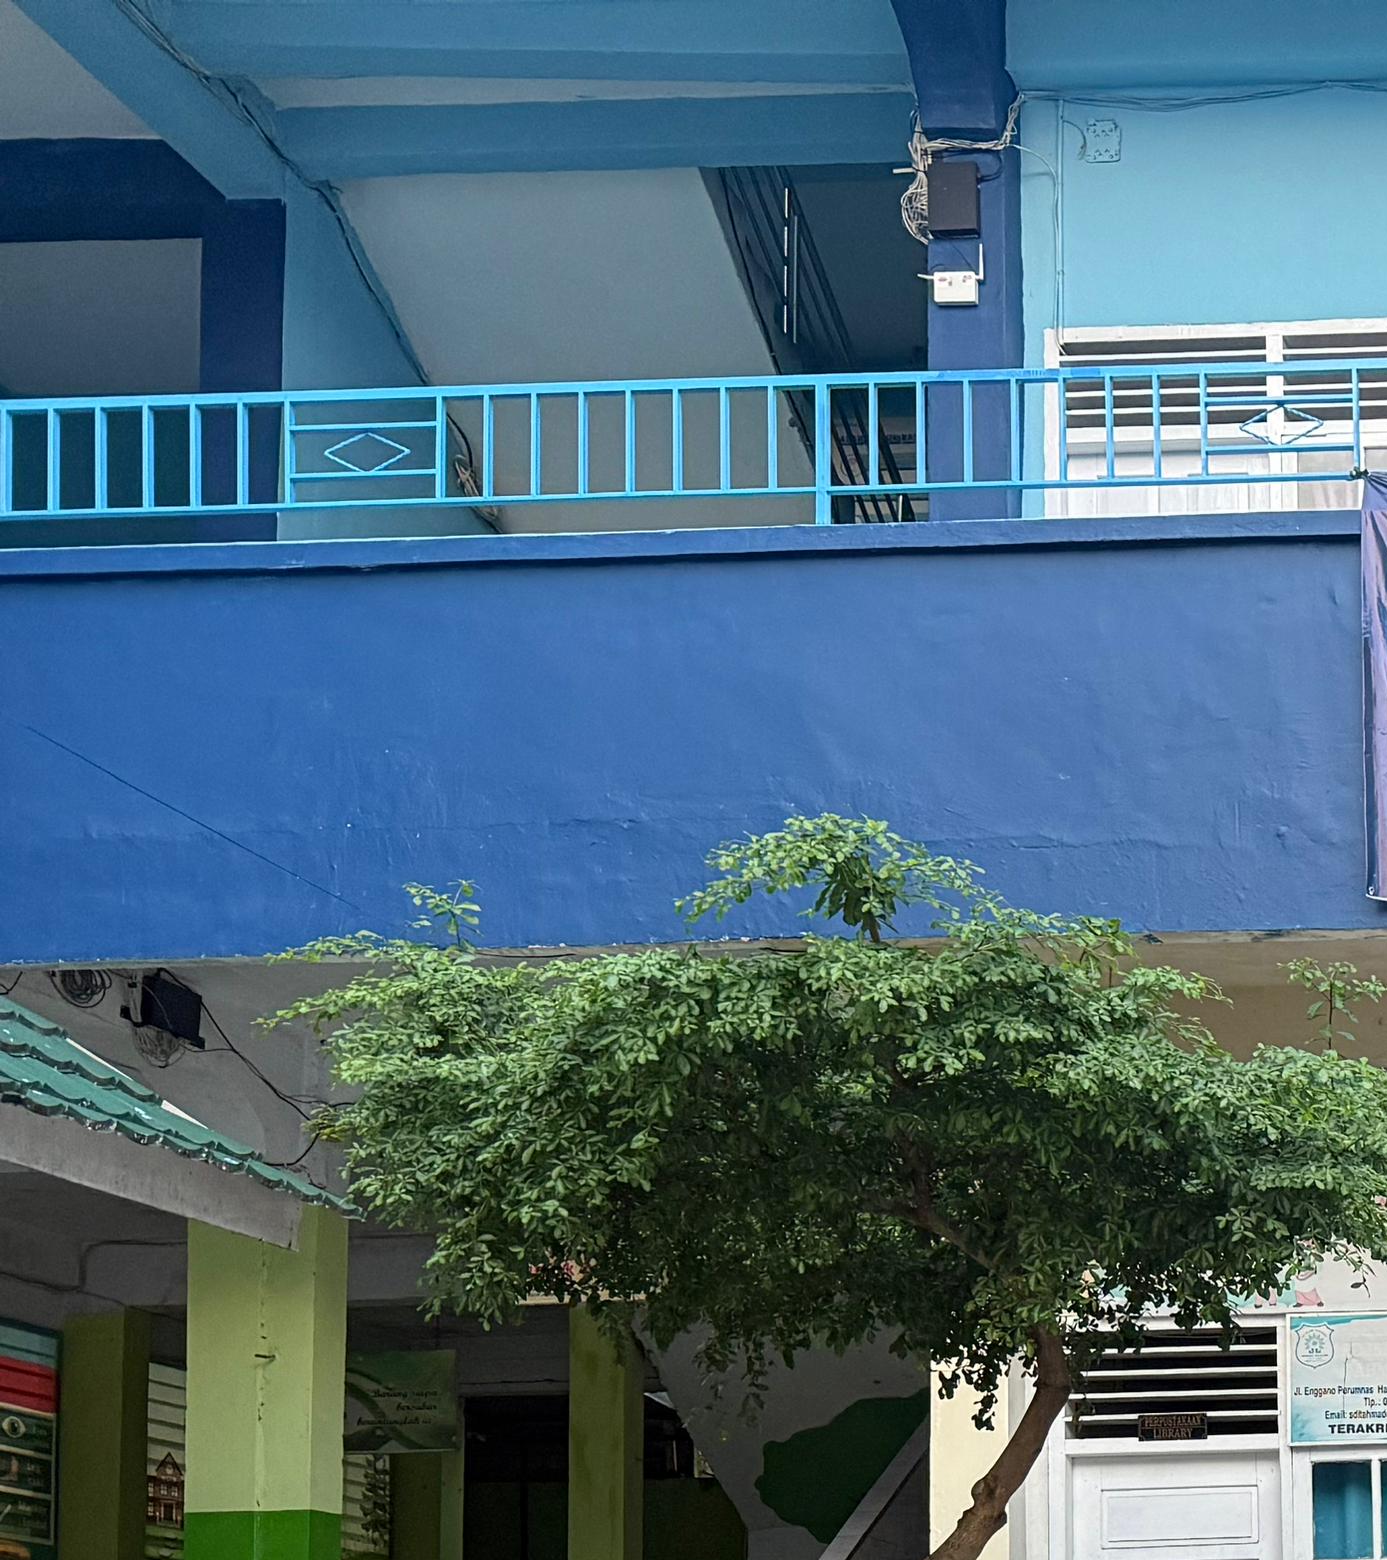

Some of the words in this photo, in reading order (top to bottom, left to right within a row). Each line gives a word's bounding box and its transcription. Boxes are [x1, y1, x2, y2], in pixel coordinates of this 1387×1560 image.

[1304, 1386, 1336, 1398] Enggano
[1338, 1385, 1374, 1395] Perumnas
[1153, 1427, 1193, 1439] LIBRARY
